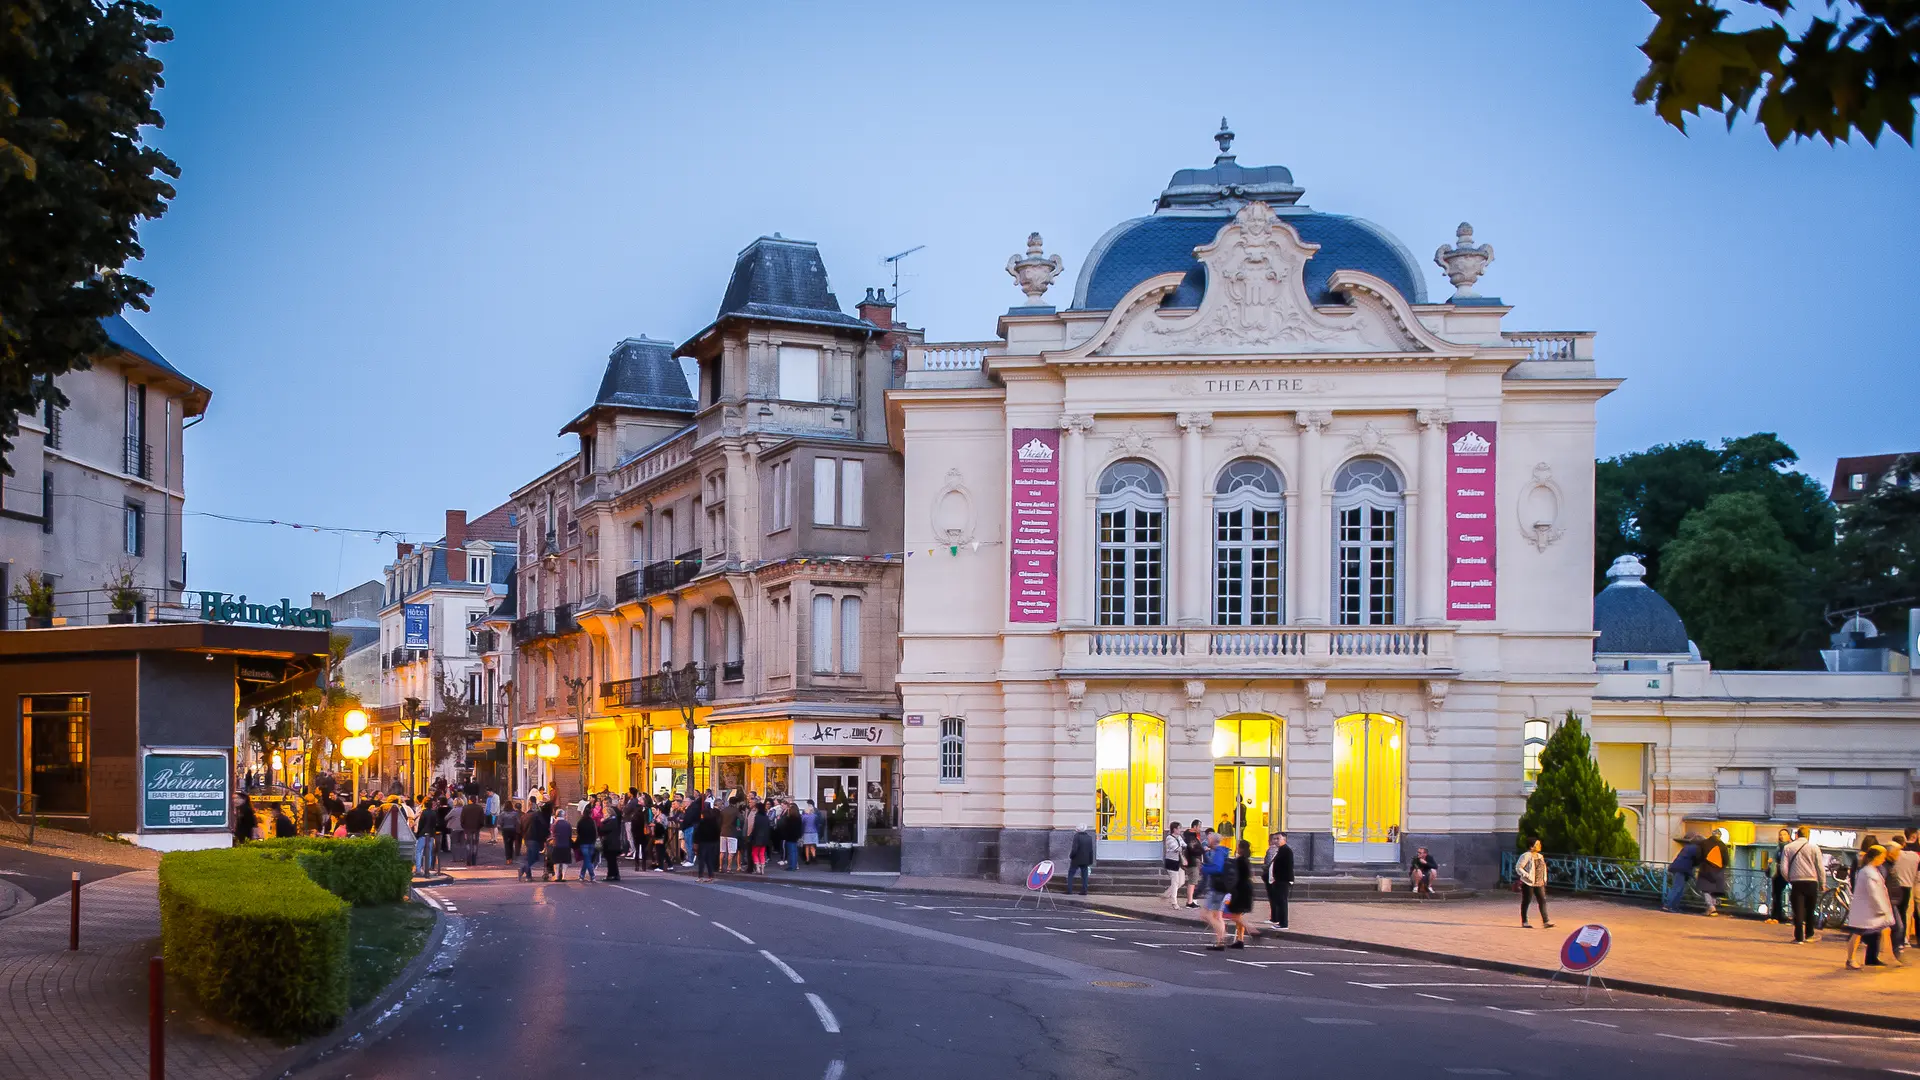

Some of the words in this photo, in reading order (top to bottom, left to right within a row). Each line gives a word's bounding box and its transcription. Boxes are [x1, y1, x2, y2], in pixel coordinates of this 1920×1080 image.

[1205, 379, 1303, 392] THEATRE
[1460, 534, 1484, 542] Cirque
[1471, 580, 1492, 588] public
[200, 591, 333, 629] Heineken
[175, 760, 195, 776] Le
